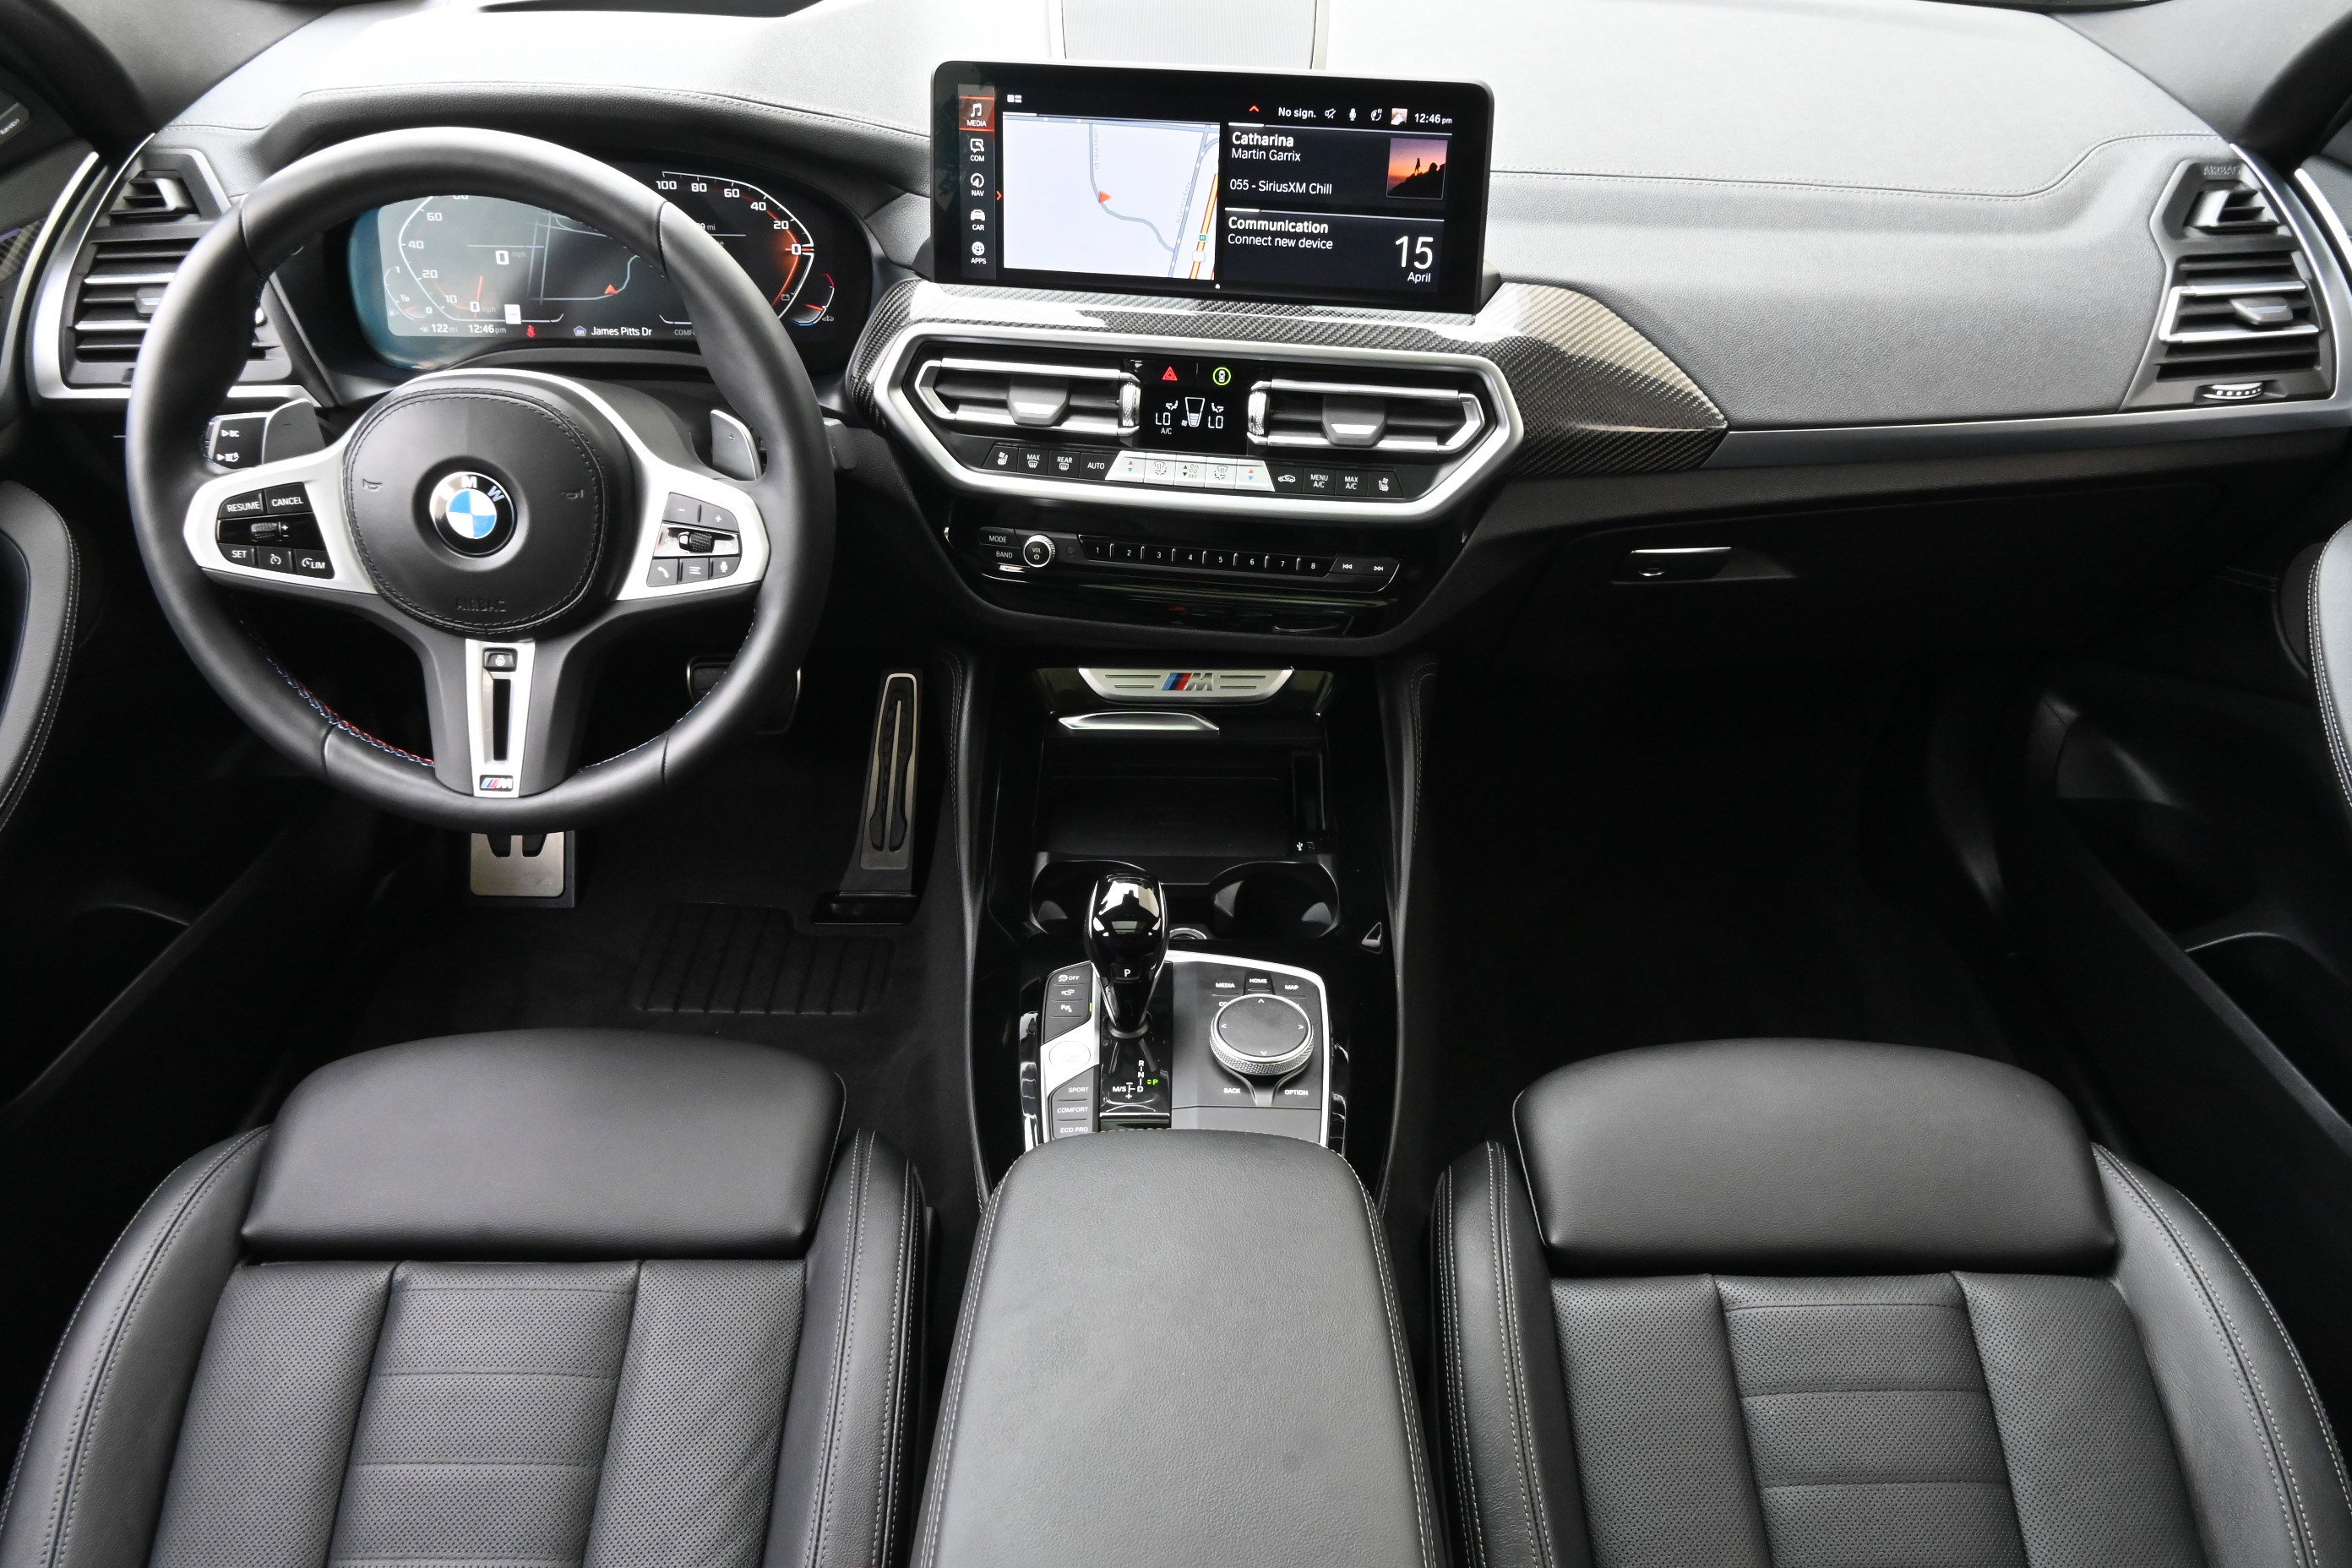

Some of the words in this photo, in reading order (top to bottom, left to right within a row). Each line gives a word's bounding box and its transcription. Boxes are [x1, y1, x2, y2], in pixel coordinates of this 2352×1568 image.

[1278, 107, 1292, 117] No
[1293, 108, 1316, 119] sign.
[1414, 113, 1440, 123] 12:46
[1441, 117, 1452, 125] pm
[1232, 132, 1293, 147] Catharina
[1232, 148, 1266, 160] Martin
[1269, 150, 1301, 161] Garrix
[656, 181, 677, 190] 100
[691, 183, 707, 193] 80
[1230, 179, 1249, 190] 055
[1258, 181, 1306, 193] SiriusXM
[1309, 182, 1332, 194] Chill
[724, 188, 740, 199] 60
[750, 202, 766, 211] 40
[427, 212, 443, 221] 60
[773, 220, 789, 230] 20
[1228, 216, 1329, 233] Communication
[408, 241, 424, 249] 40
[1228, 234, 1271, 247] Connect
[1274, 237, 1296, 248] new
[1298, 238, 1333, 250] device
[791, 244, 802, 255] 0
[1395, 236, 1434, 270] 15
[495, 250, 509, 264] 0
[422, 270, 438, 279] 20
[1407, 271, 1431, 284] April
[445, 295, 457, 303] 10
[470, 302, 480, 313] 0
[432, 324, 449, 333] 122
[468, 324, 494, 334] 12:46
[591, 327, 619, 336] James
[620, 327, 640, 336] Pitts
[641, 327, 652, 336] Dr
[1155, 412, 1171, 425] LO
[1208, 416, 1223, 429] LO
[226, 501, 260, 512] RESUME
[271, 497, 303, 507] CANCEL
[311, 561, 325, 569] LIM
[1124, 969, 1131, 977] P
